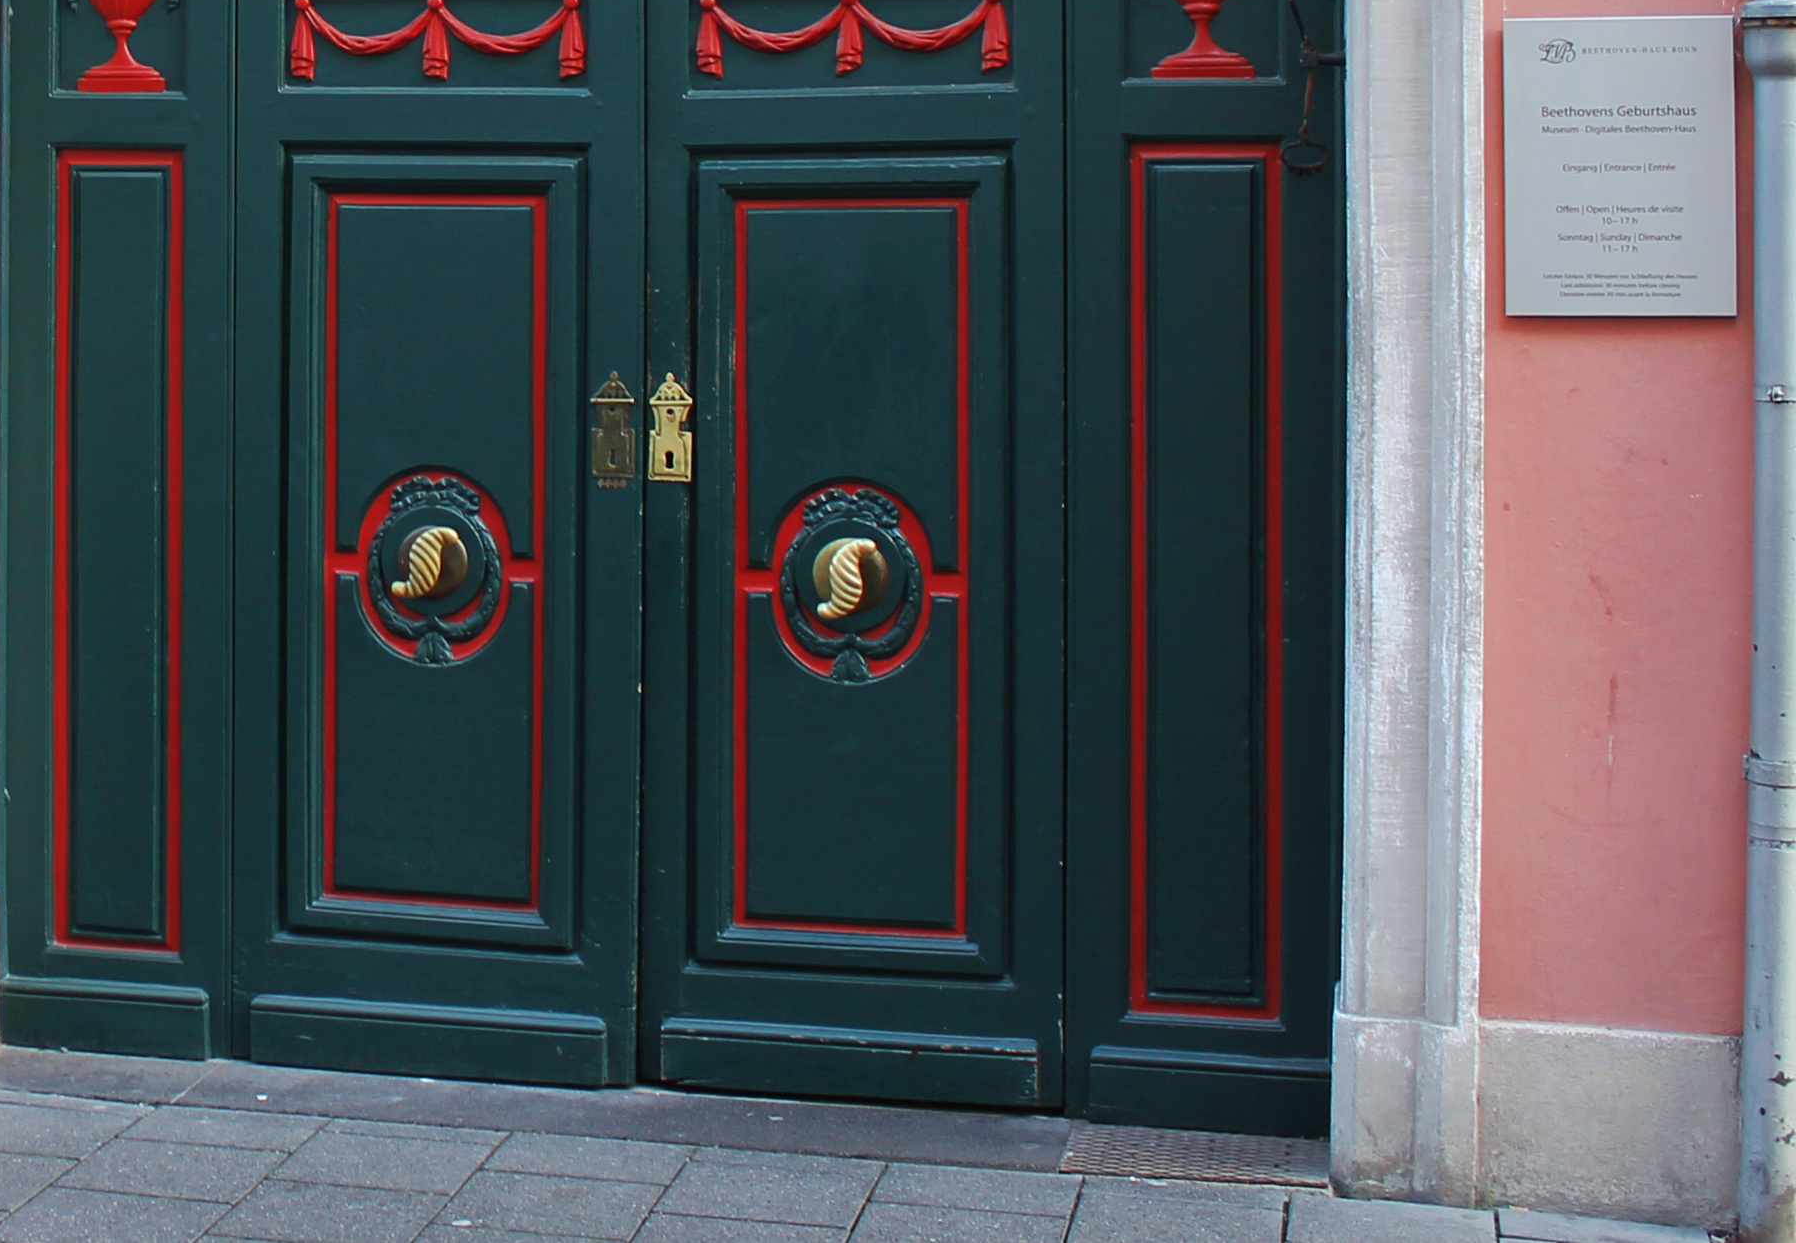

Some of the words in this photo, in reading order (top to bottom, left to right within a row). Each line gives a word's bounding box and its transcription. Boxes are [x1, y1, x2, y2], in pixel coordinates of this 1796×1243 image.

[1541, 105, 1614, 118] Beethovens
[1616, 104, 1697, 118] Geburtshaus
[1541, 126, 1579, 134] Museum
[1584, 125, 1623, 136] Digitales
[1625, 125, 1697, 134] Beethoven-Haus
[1562, 163, 1598, 173] Eingang
[1604, 163, 1642, 172] Entrance
[1555, 205, 1580, 214] Offen
[1585, 205, 1610, 215] Open
[1615, 205, 1646, 214] Heures
[1648, 205, 1659, 214] de
[1661, 205, 1684, 214] visite
[1557, 232, 1594, 243] Sonntag
[1600, 232, 1632, 243] Sunday
[1638, 232, 1683, 242] Dimanche
